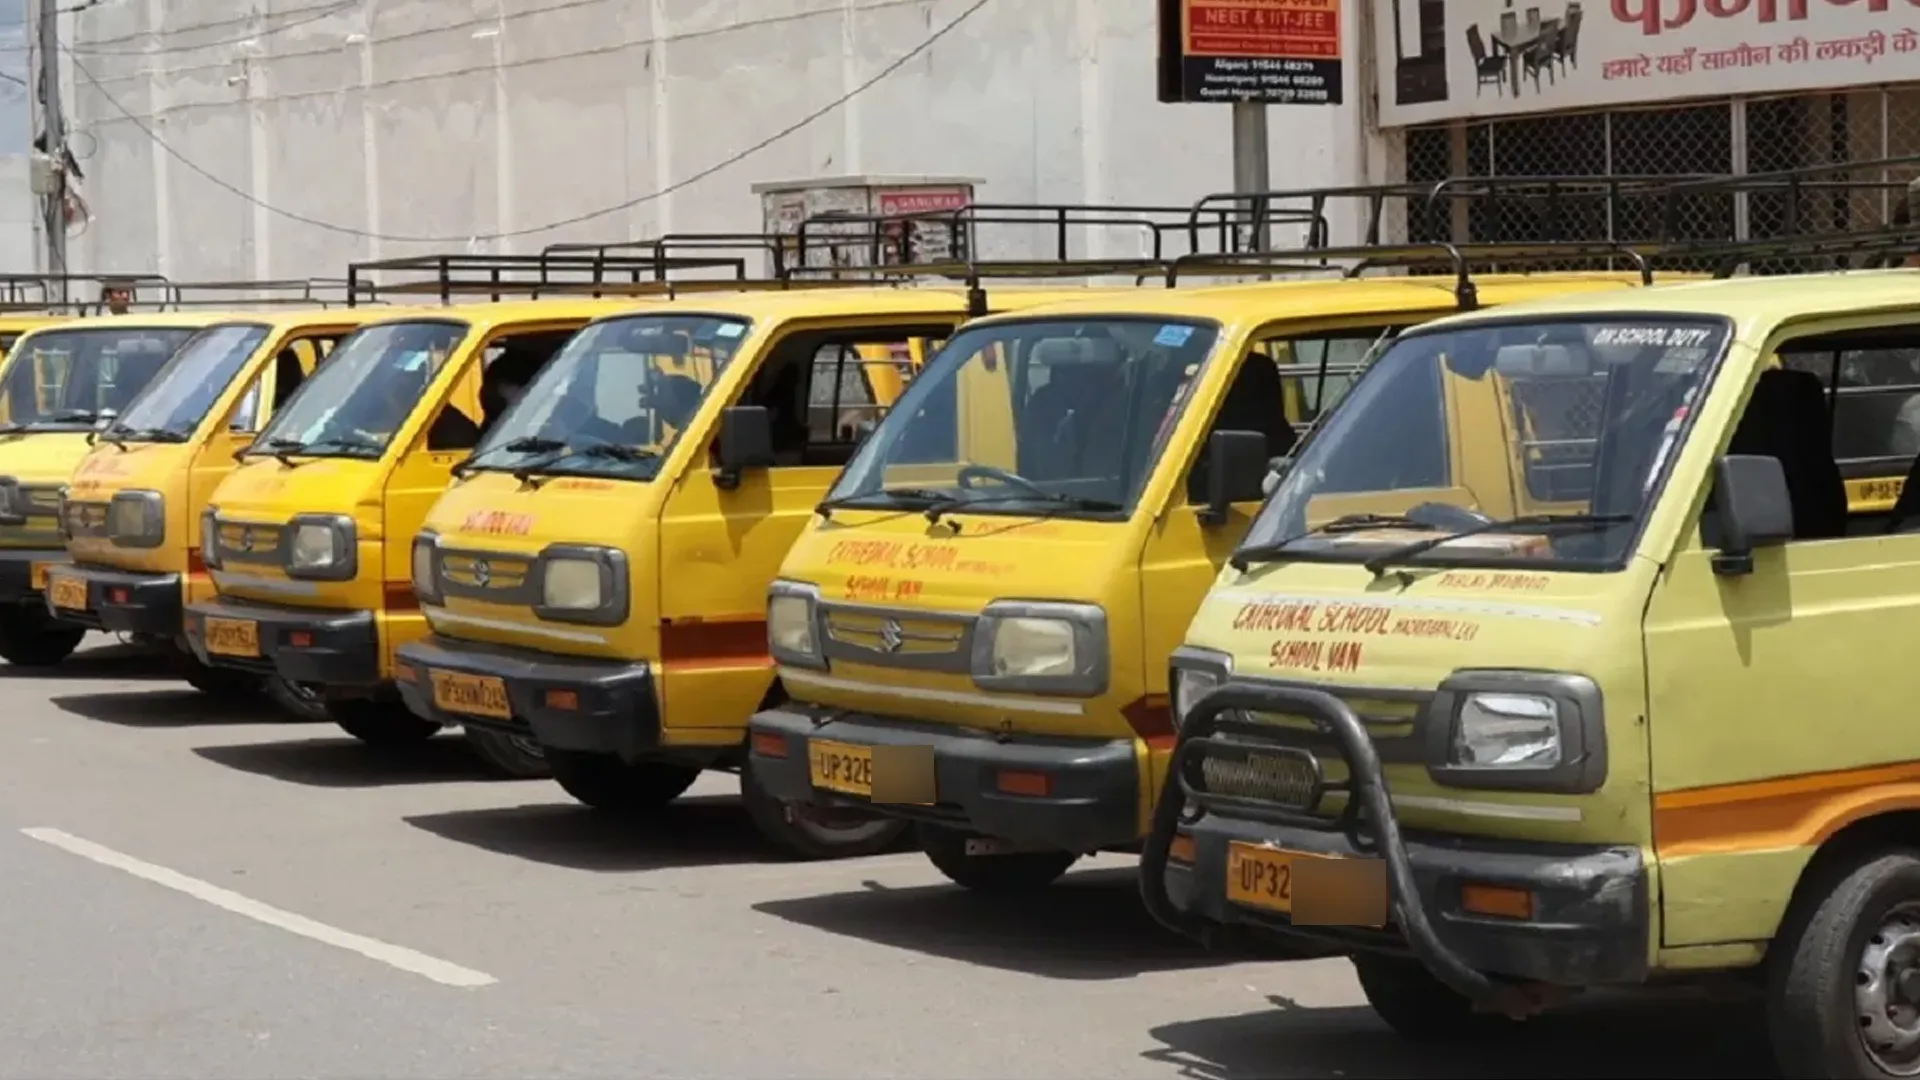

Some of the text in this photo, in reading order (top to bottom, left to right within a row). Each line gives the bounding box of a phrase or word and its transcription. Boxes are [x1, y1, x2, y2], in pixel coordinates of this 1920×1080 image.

[1205, 8, 1325, 28] NEET & IIT-JEE
[1602, 53, 1650, 79] हमारे
[1778, 36, 1808, 64] की
[1893, 27, 1918, 53] के
[1666, 328, 1711, 346] DUTY
[1317, 606, 1392, 635] SCHOOL
[1269, 640, 1363, 671] SCHOOL VAN
